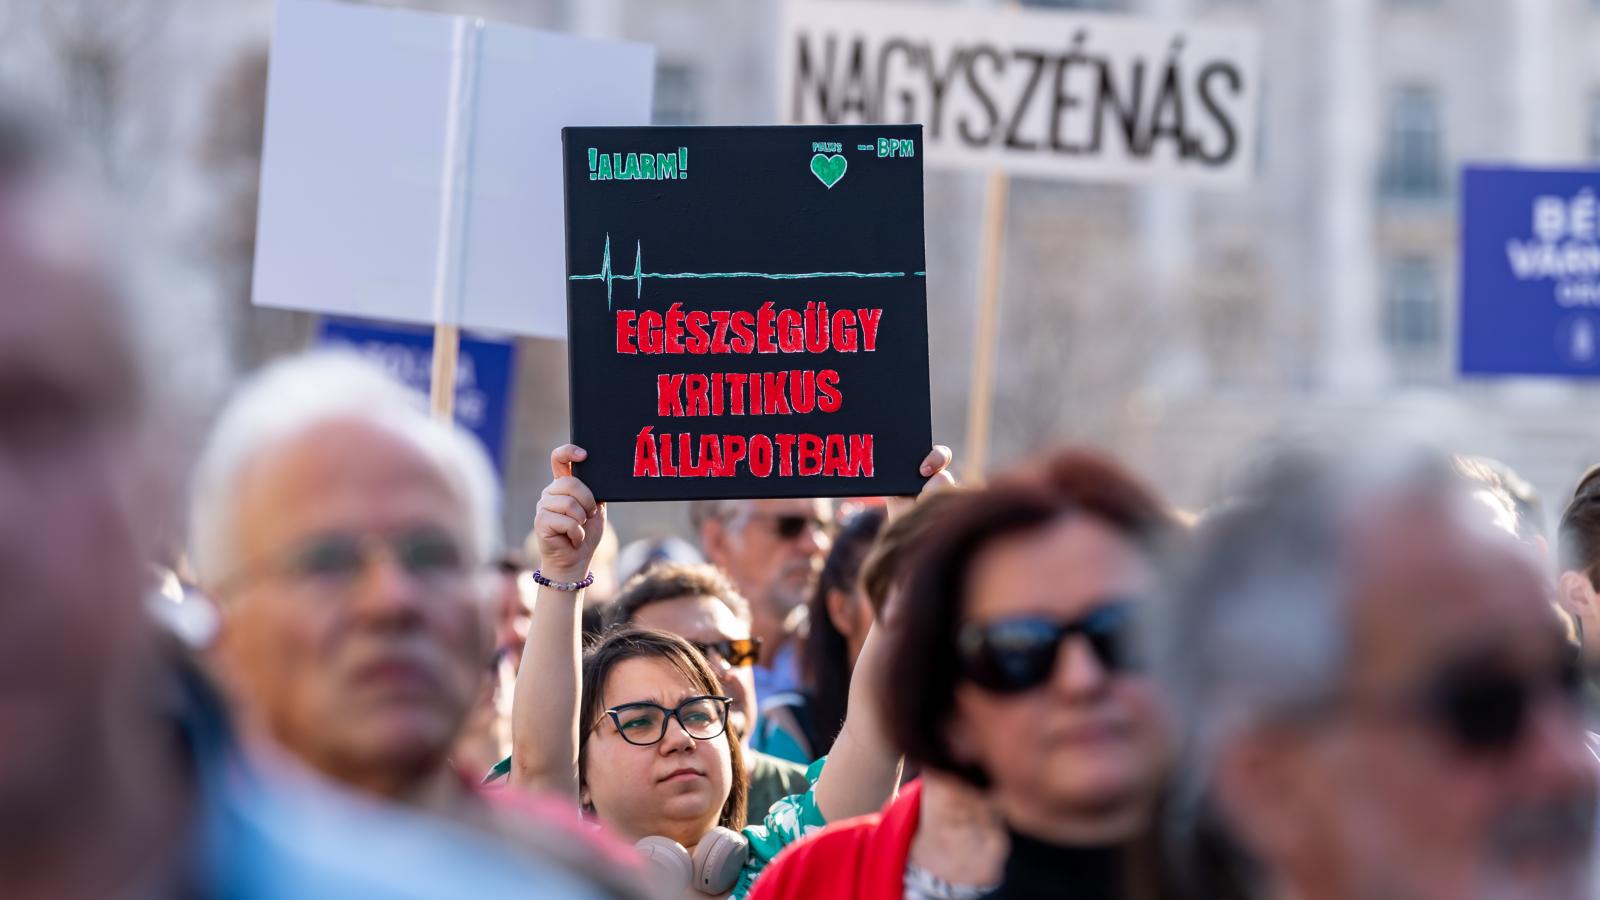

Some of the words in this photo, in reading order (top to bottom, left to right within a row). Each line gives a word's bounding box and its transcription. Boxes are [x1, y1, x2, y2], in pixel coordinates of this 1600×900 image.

[791, 29, 1243, 167] NAGYSZÉNÁS
[588, 147, 688, 180] !ALARM!
[1532, 187, 1600, 240] BÉ
[616, 301, 883, 355] EGÉSZSÉGÜGY
[657, 369, 843, 417] KRITIKUS
[633, 426, 875, 477] ÁLLAPOTBAN
